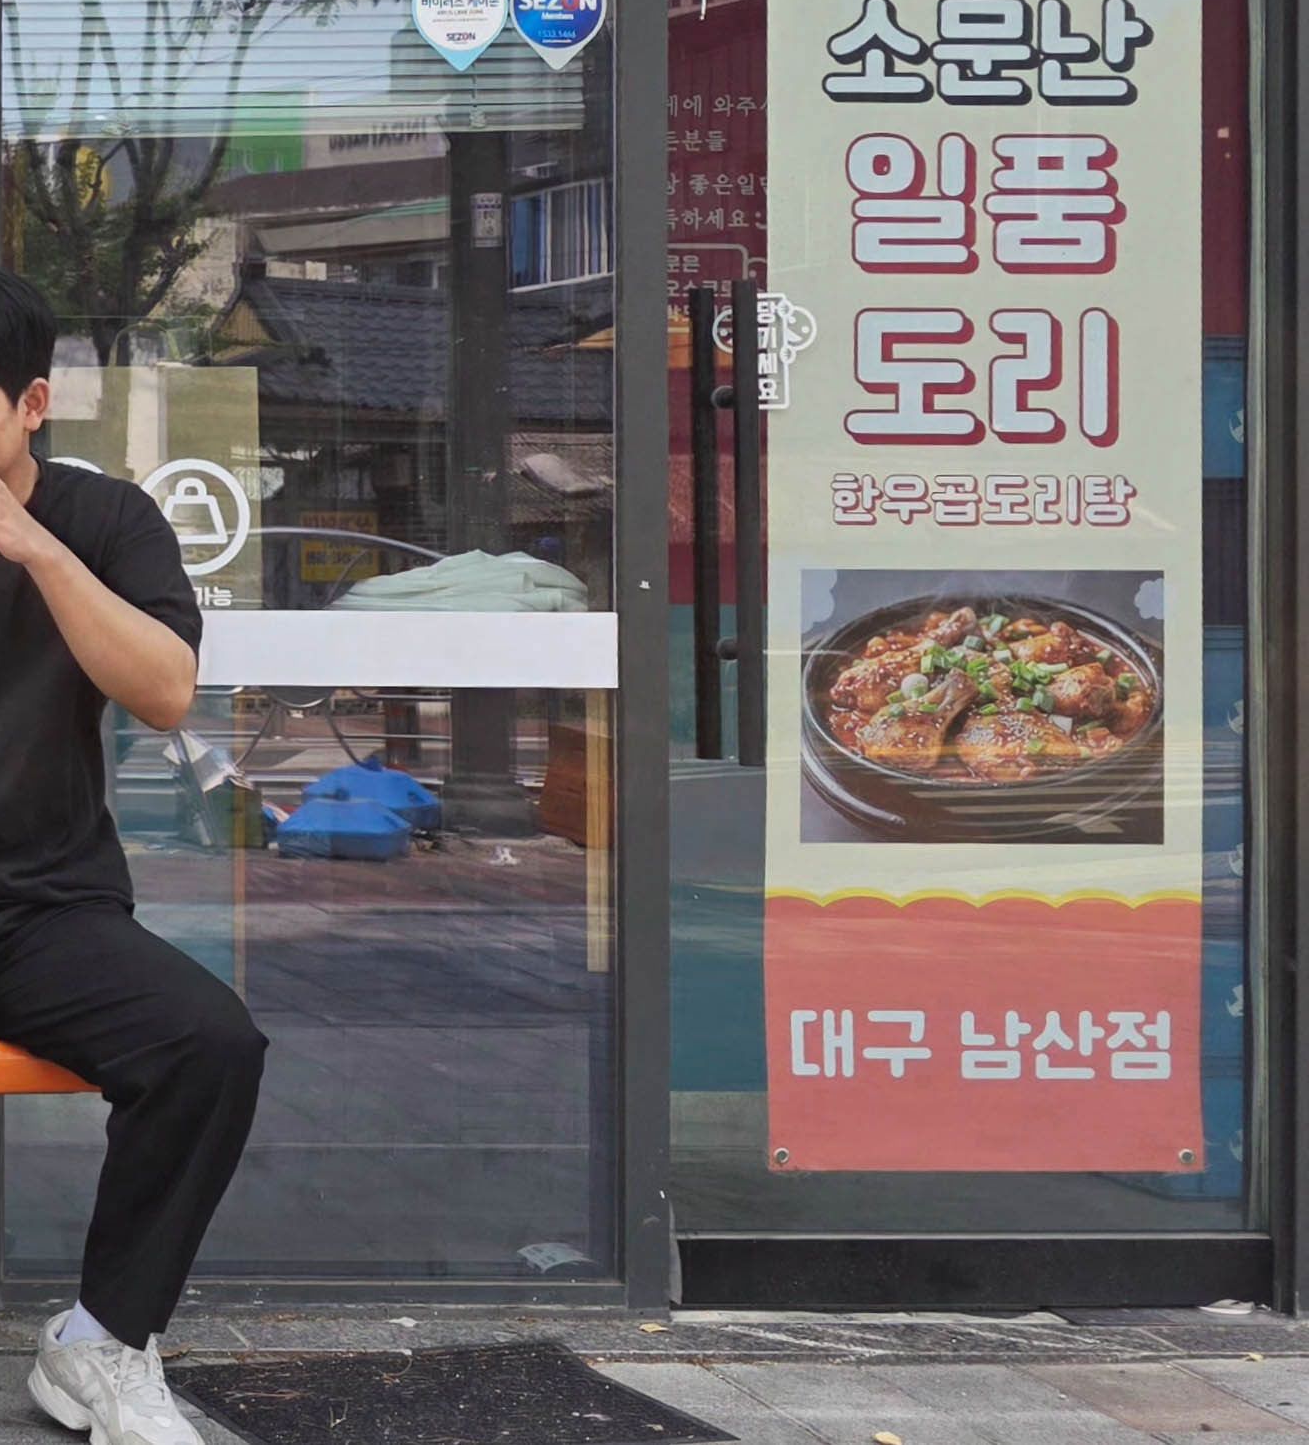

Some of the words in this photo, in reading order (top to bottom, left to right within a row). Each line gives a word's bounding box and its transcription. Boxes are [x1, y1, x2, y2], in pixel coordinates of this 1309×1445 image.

[846, 132, 1127, 275] 일품
[844, 307, 1120, 448] 도리
[830, 473, 1136, 526] 한우곱도리탕
[790, 1009, 932, 1078] 대구
[960, 1010, 1172, 1080] 남산점
